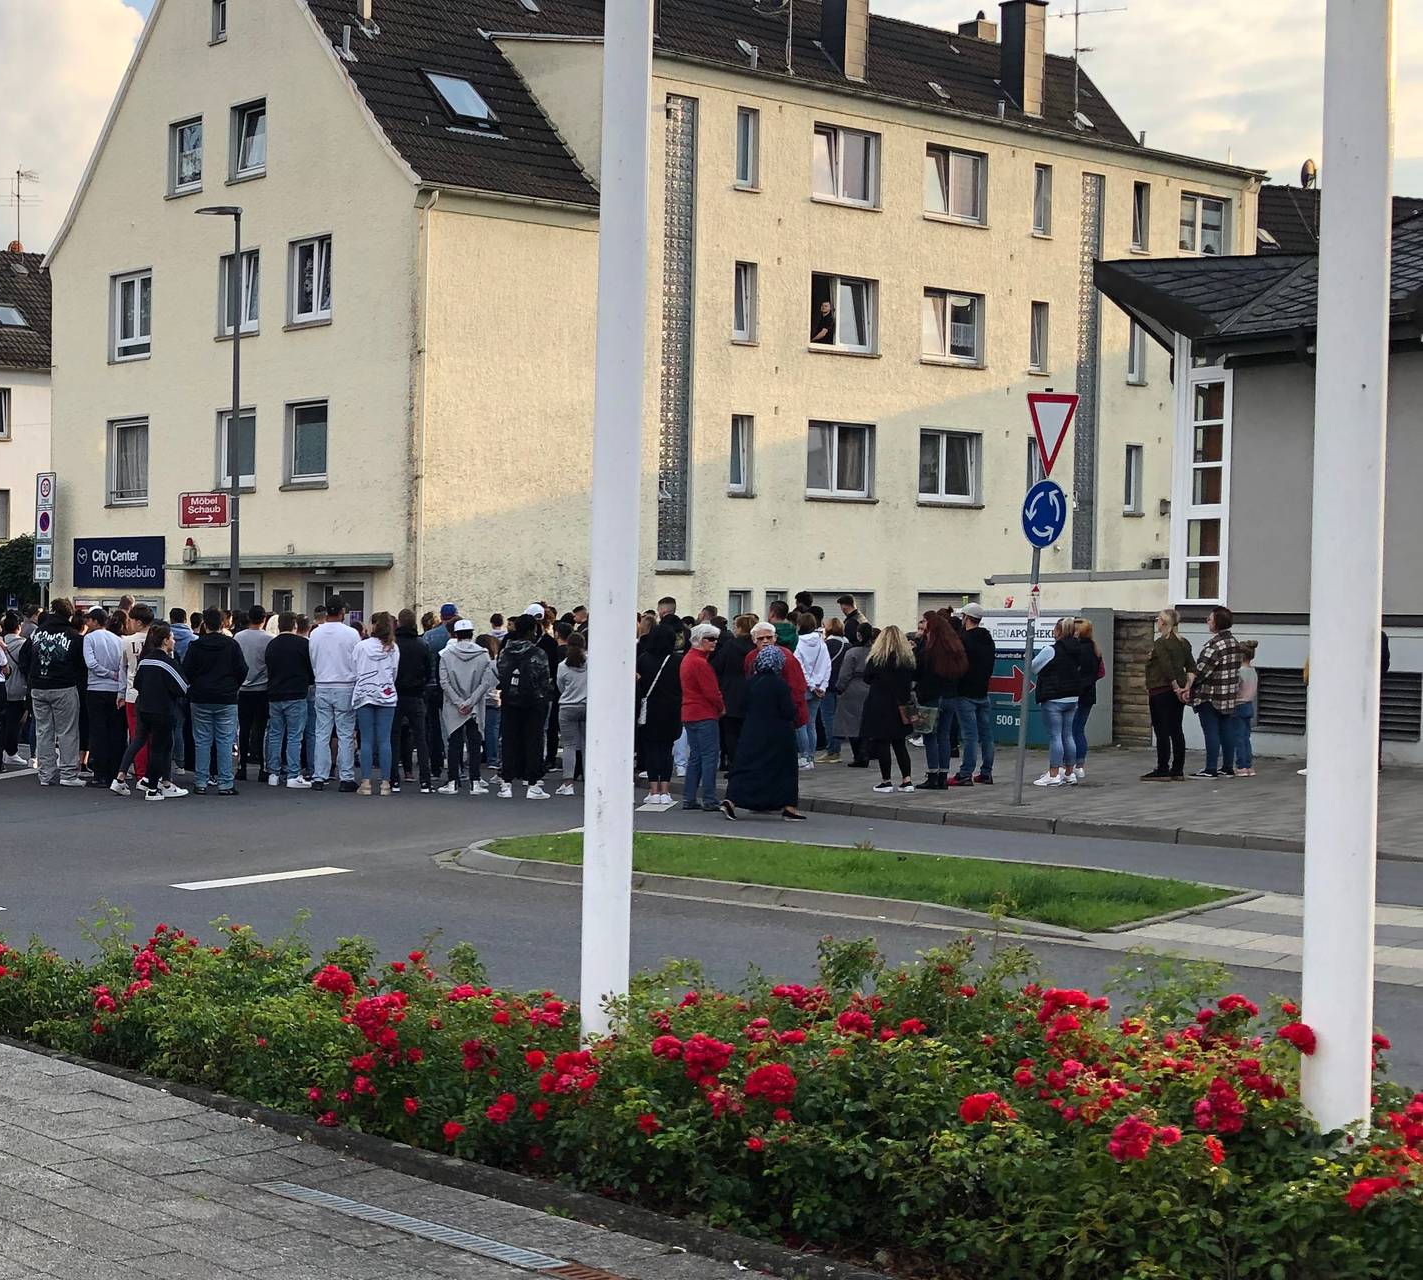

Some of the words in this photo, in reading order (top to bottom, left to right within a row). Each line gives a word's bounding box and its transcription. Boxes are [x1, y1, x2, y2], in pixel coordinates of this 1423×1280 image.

[190, 496, 218, 505] Möbel
[187, 505, 222, 514] Schaub
[91, 549, 110, 564] City
[110, 549, 139, 562] Center
[92, 565, 112, 578] RVR
[113, 564, 157, 578] Reisebüro
[996, 714, 1013, 726] 500
